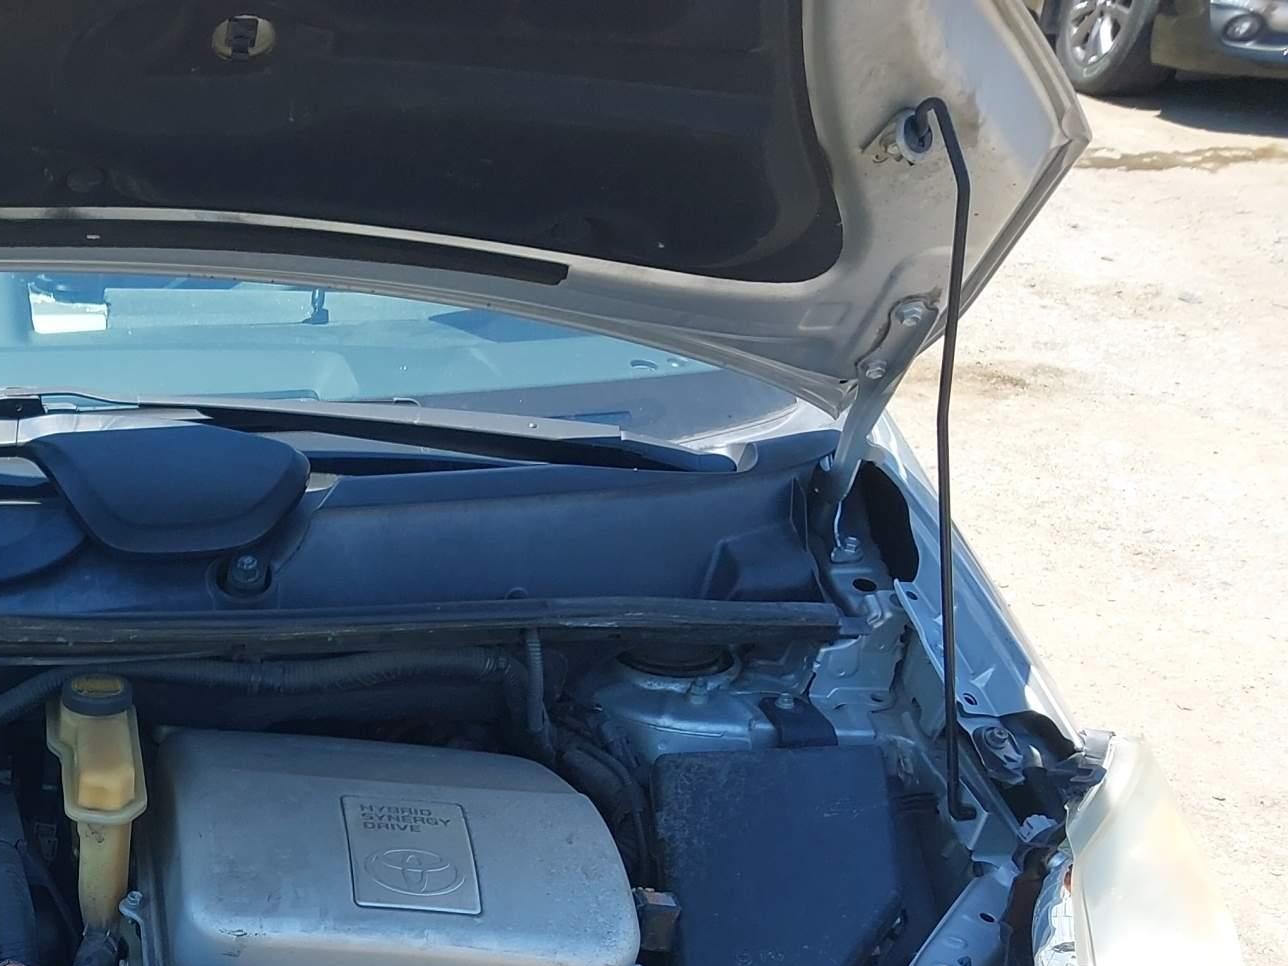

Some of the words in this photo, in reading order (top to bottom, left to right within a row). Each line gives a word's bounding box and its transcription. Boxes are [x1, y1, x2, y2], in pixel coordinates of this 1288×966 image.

[360, 804, 432, 816] HYBRID
[361, 813, 451, 826] SYNERGY
[363, 822, 421, 832] DRIVE
